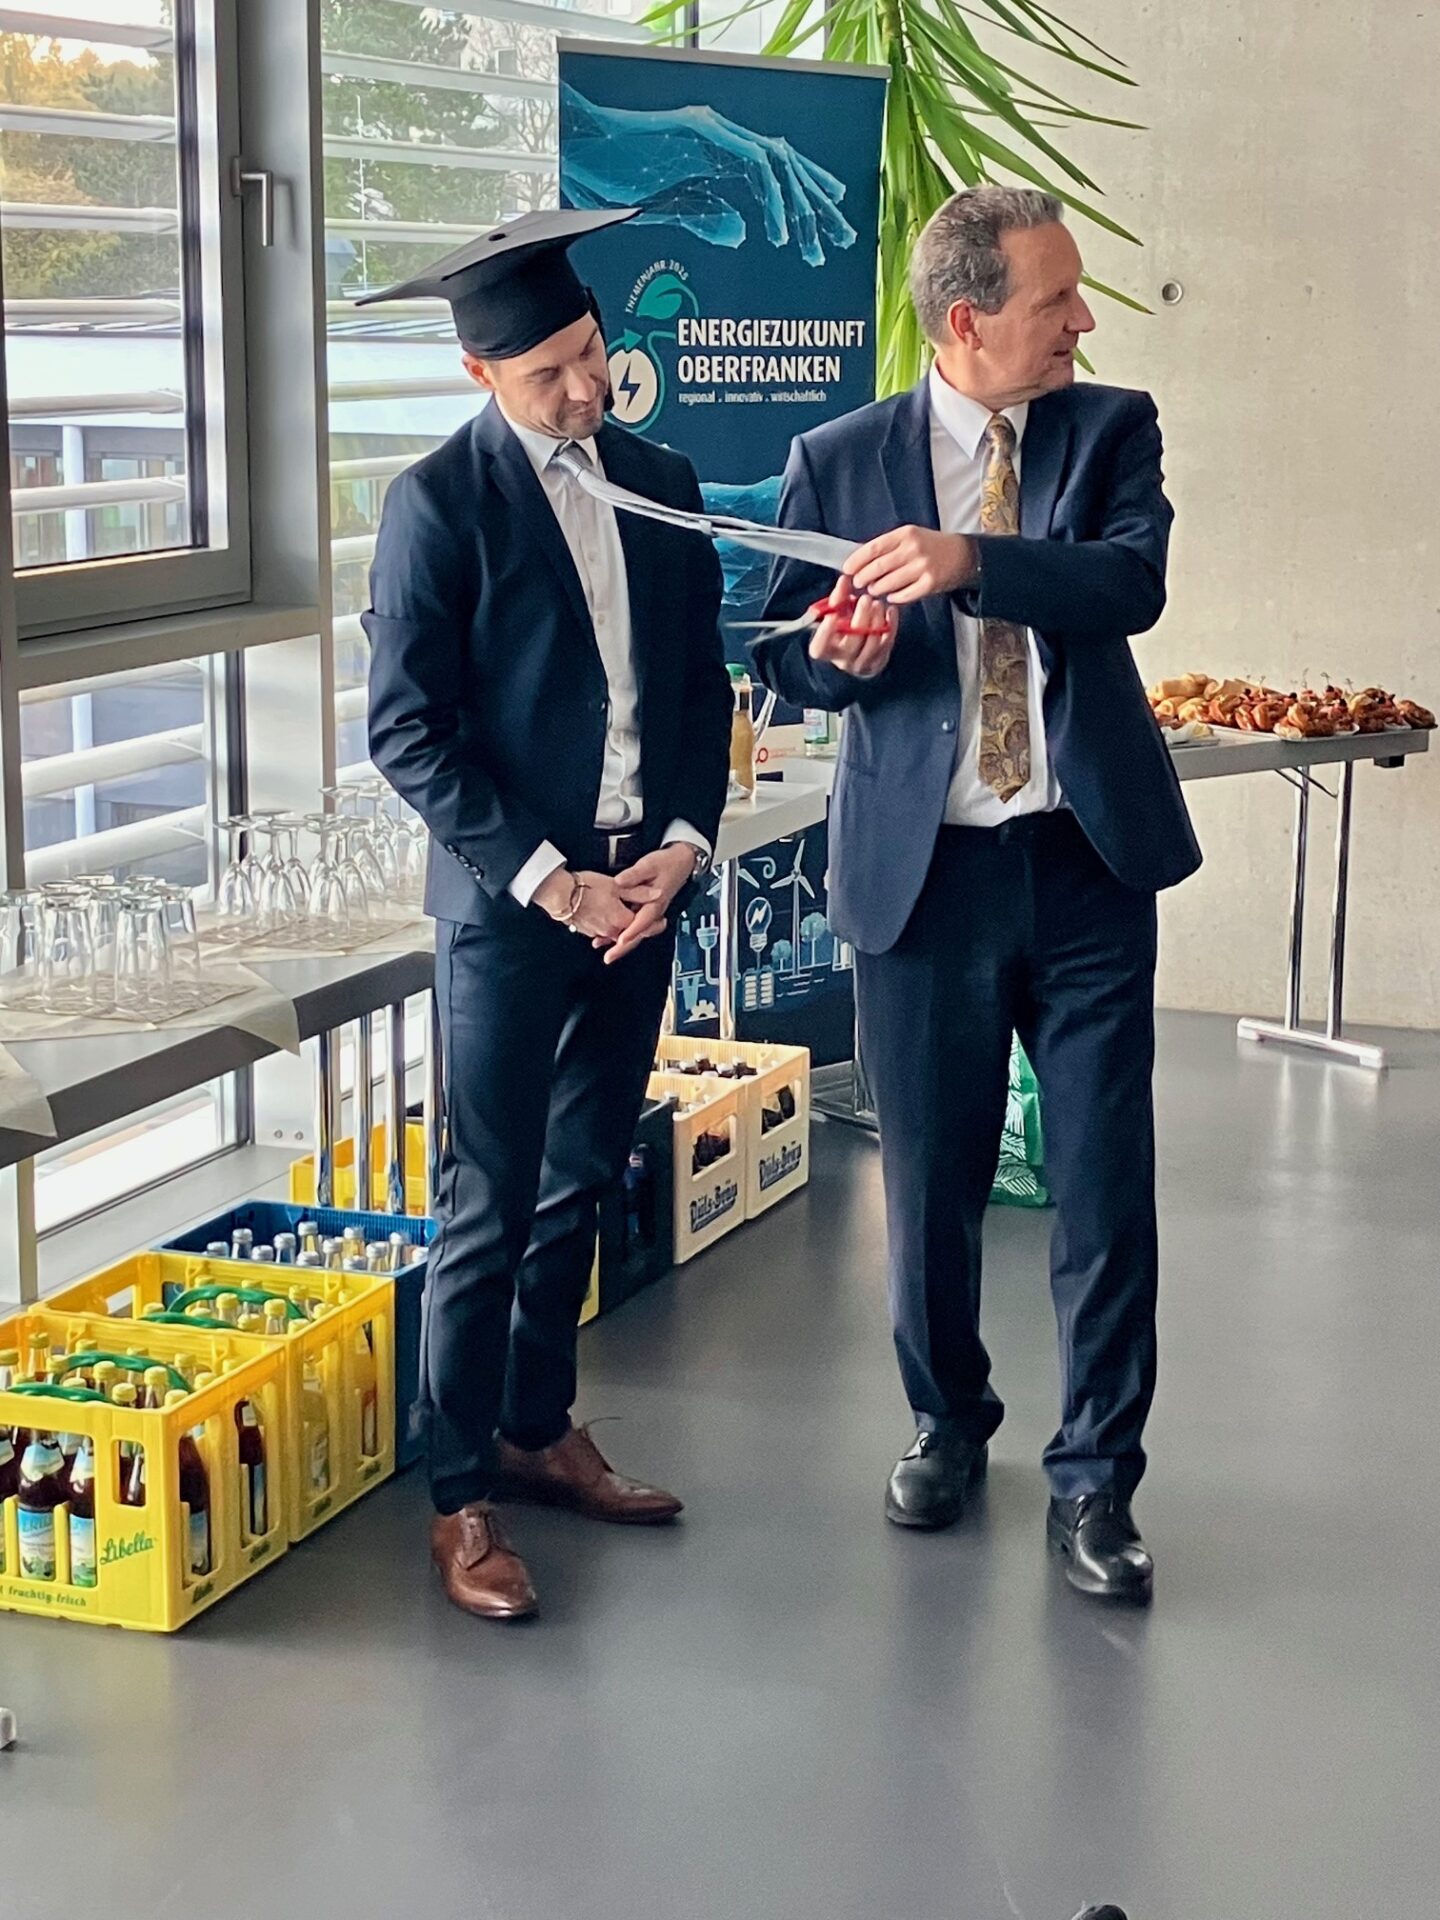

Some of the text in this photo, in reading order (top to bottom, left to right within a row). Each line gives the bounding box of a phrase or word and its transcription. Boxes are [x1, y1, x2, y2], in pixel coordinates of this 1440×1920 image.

[625, 259, 689, 314] THEMENJAHR 2025
[677, 318, 866, 348] ENERGIEZUKUNFT
[677, 354, 841, 384] OBERFRANKEN
[678, 389, 827, 406] regional innovativ wirtschaftlich
[99, 1529, 154, 1566] Libella
